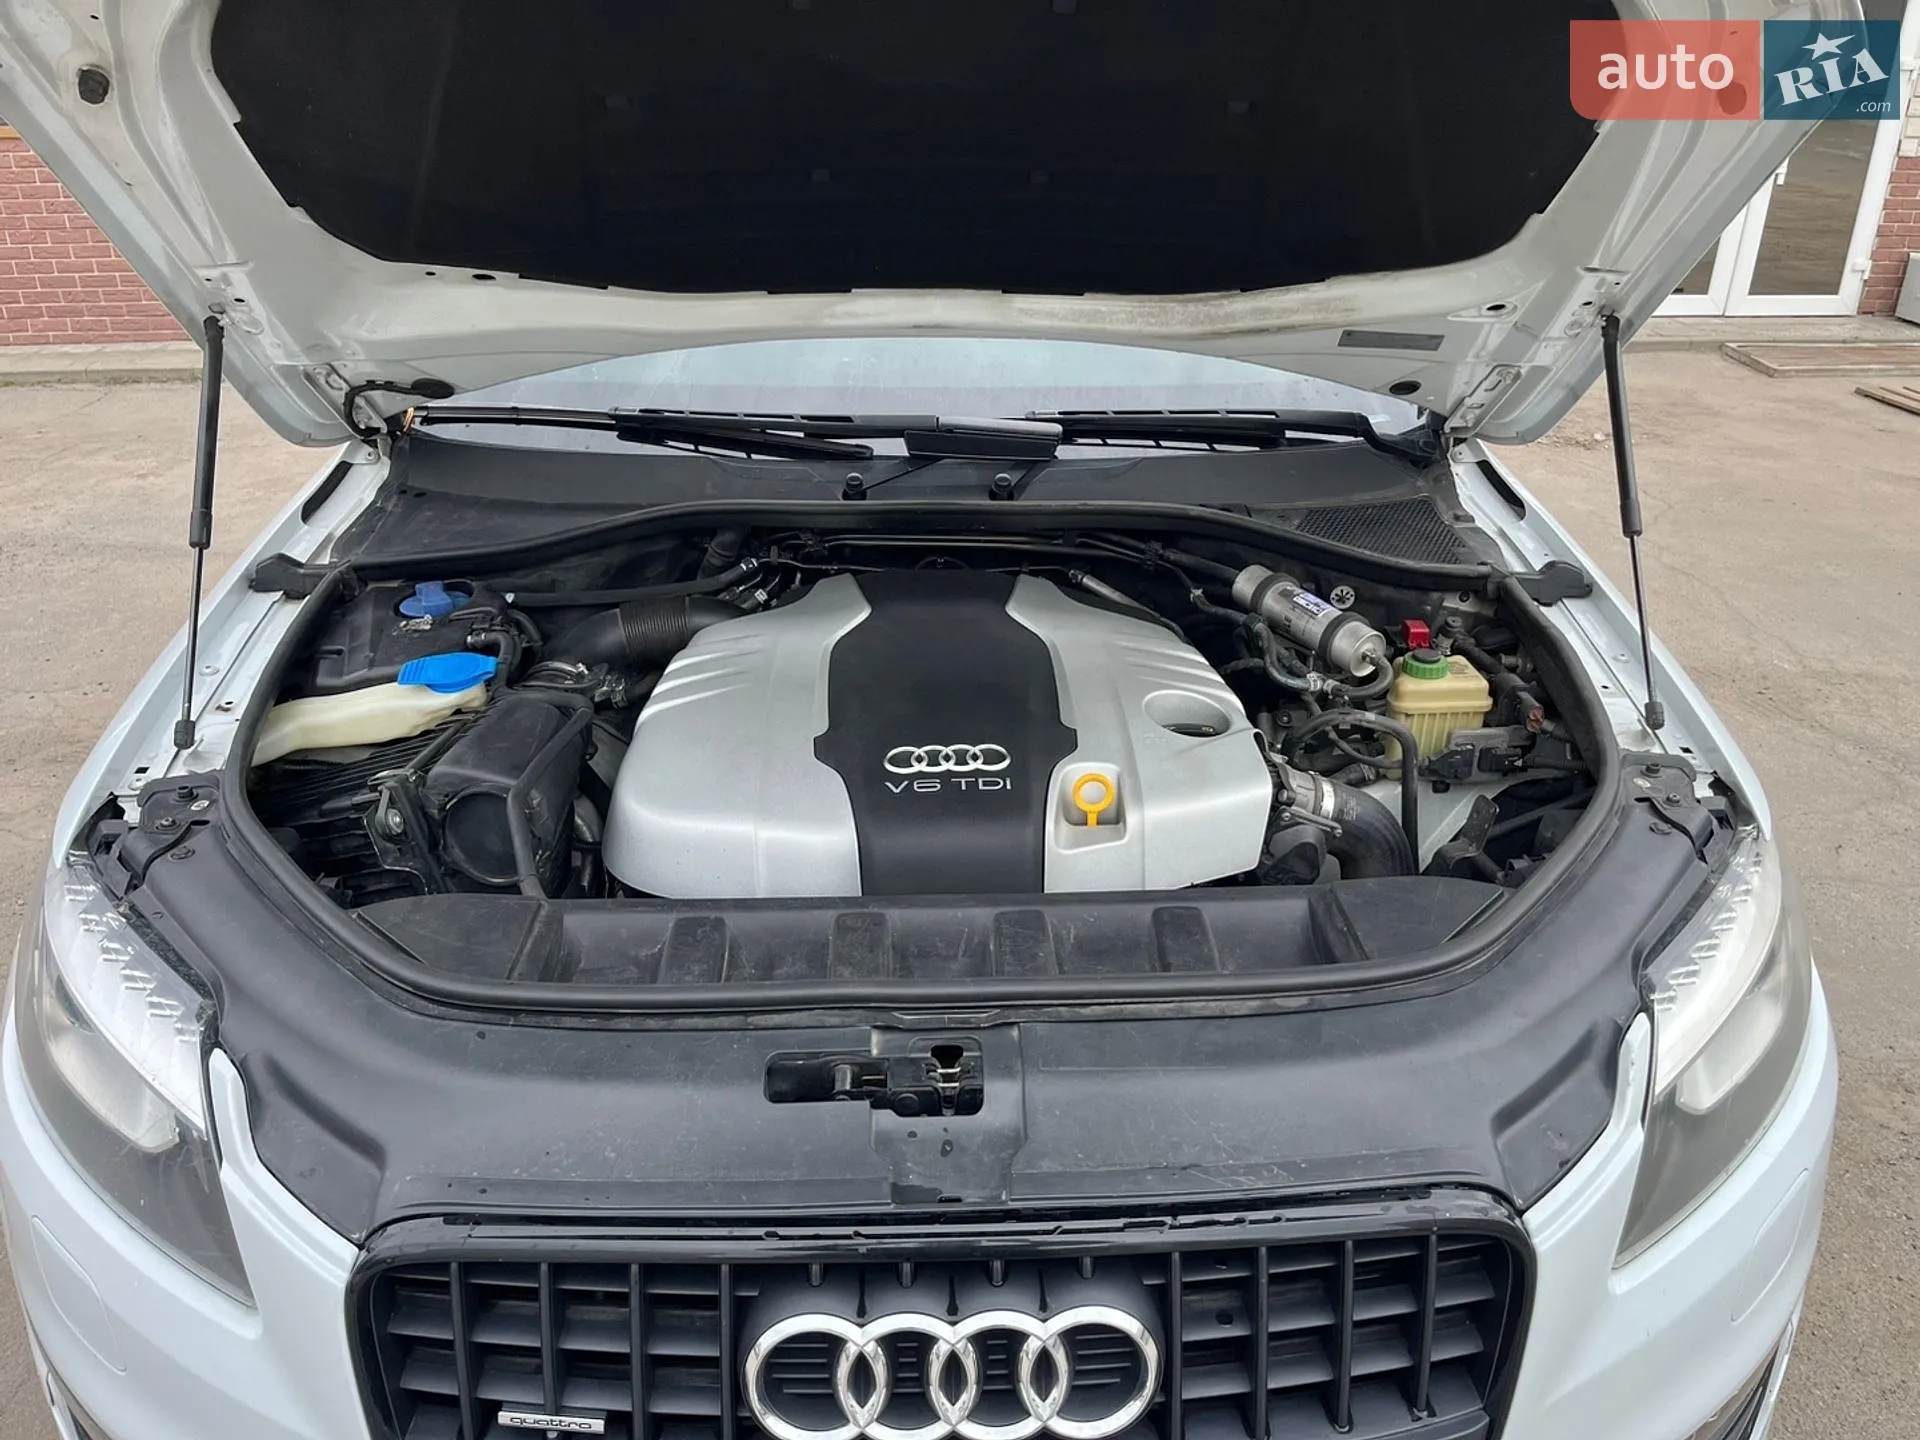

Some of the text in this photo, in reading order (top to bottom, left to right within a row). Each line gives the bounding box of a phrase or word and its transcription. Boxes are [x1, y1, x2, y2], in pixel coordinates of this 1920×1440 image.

[884, 776, 1012, 794] V6 TDI
[509, 1416, 592, 1430] quattro
